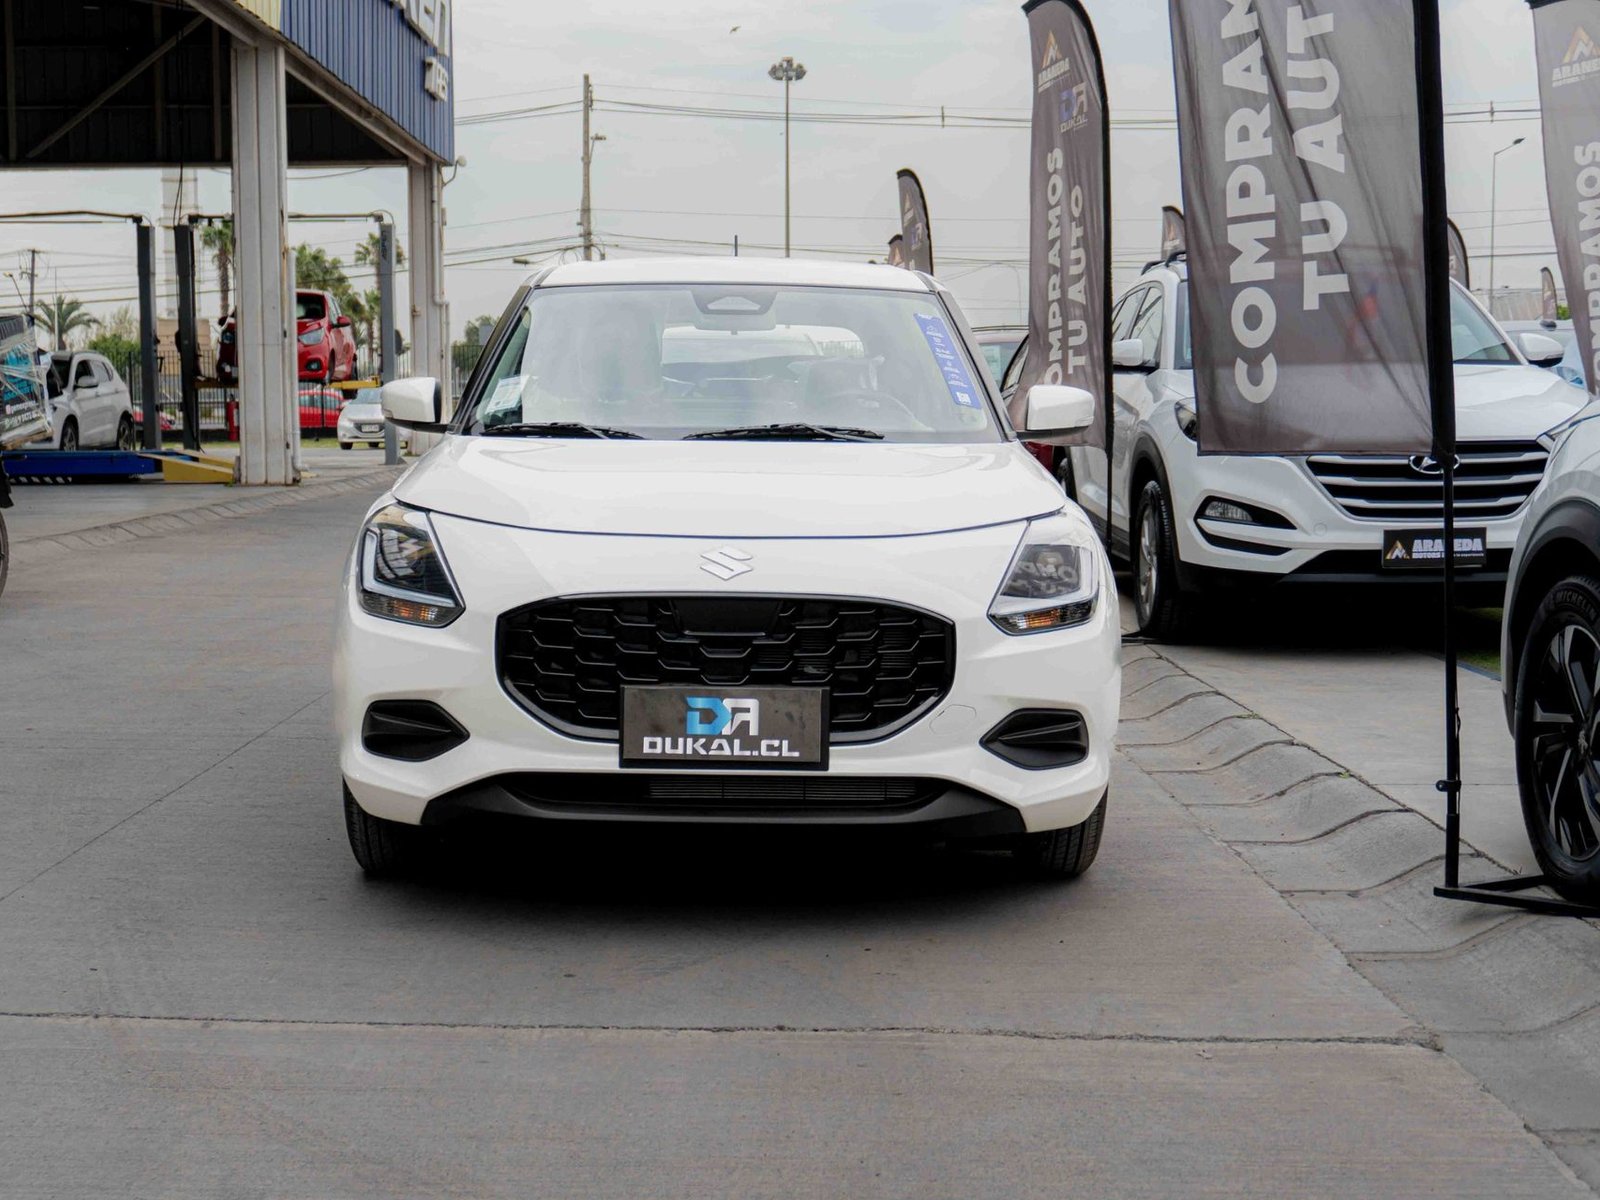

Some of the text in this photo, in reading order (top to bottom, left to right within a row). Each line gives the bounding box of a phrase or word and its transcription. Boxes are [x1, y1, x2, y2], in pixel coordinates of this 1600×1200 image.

[1043, 147, 1064, 386] OMPRAMOS
[1067, 184, 1088, 375] TU AUTO
[1302, 200, 1350, 311] TU
[1412, 538, 1483, 552] ARAEDA
[643, 736, 800, 757] DUKAL.CL
